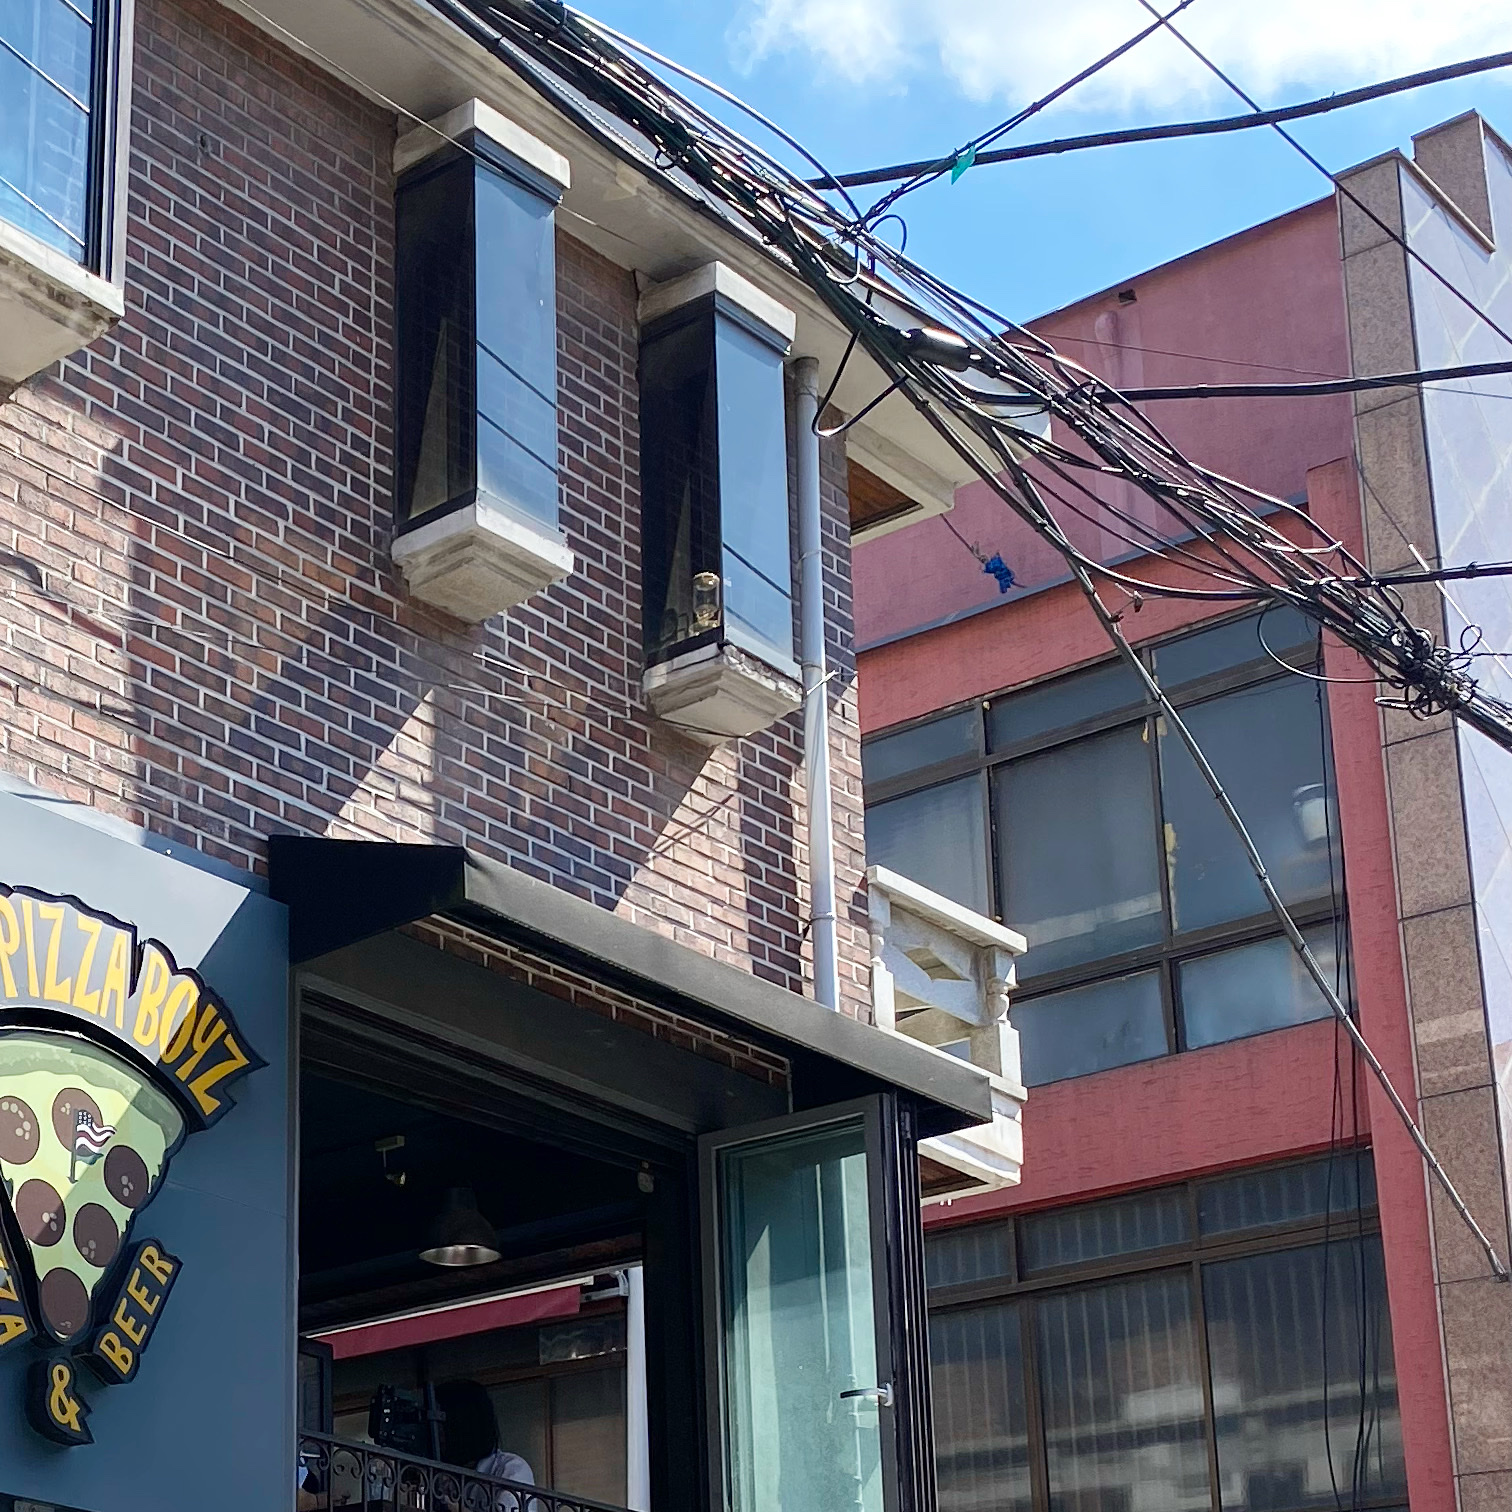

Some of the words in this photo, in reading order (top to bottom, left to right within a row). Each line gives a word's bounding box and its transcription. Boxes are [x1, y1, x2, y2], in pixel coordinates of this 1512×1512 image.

[133, 952, 250, 1116] BOYZ
[100, 1246, 173, 1375] BEER
[50, 1364, 81, 1431] &
